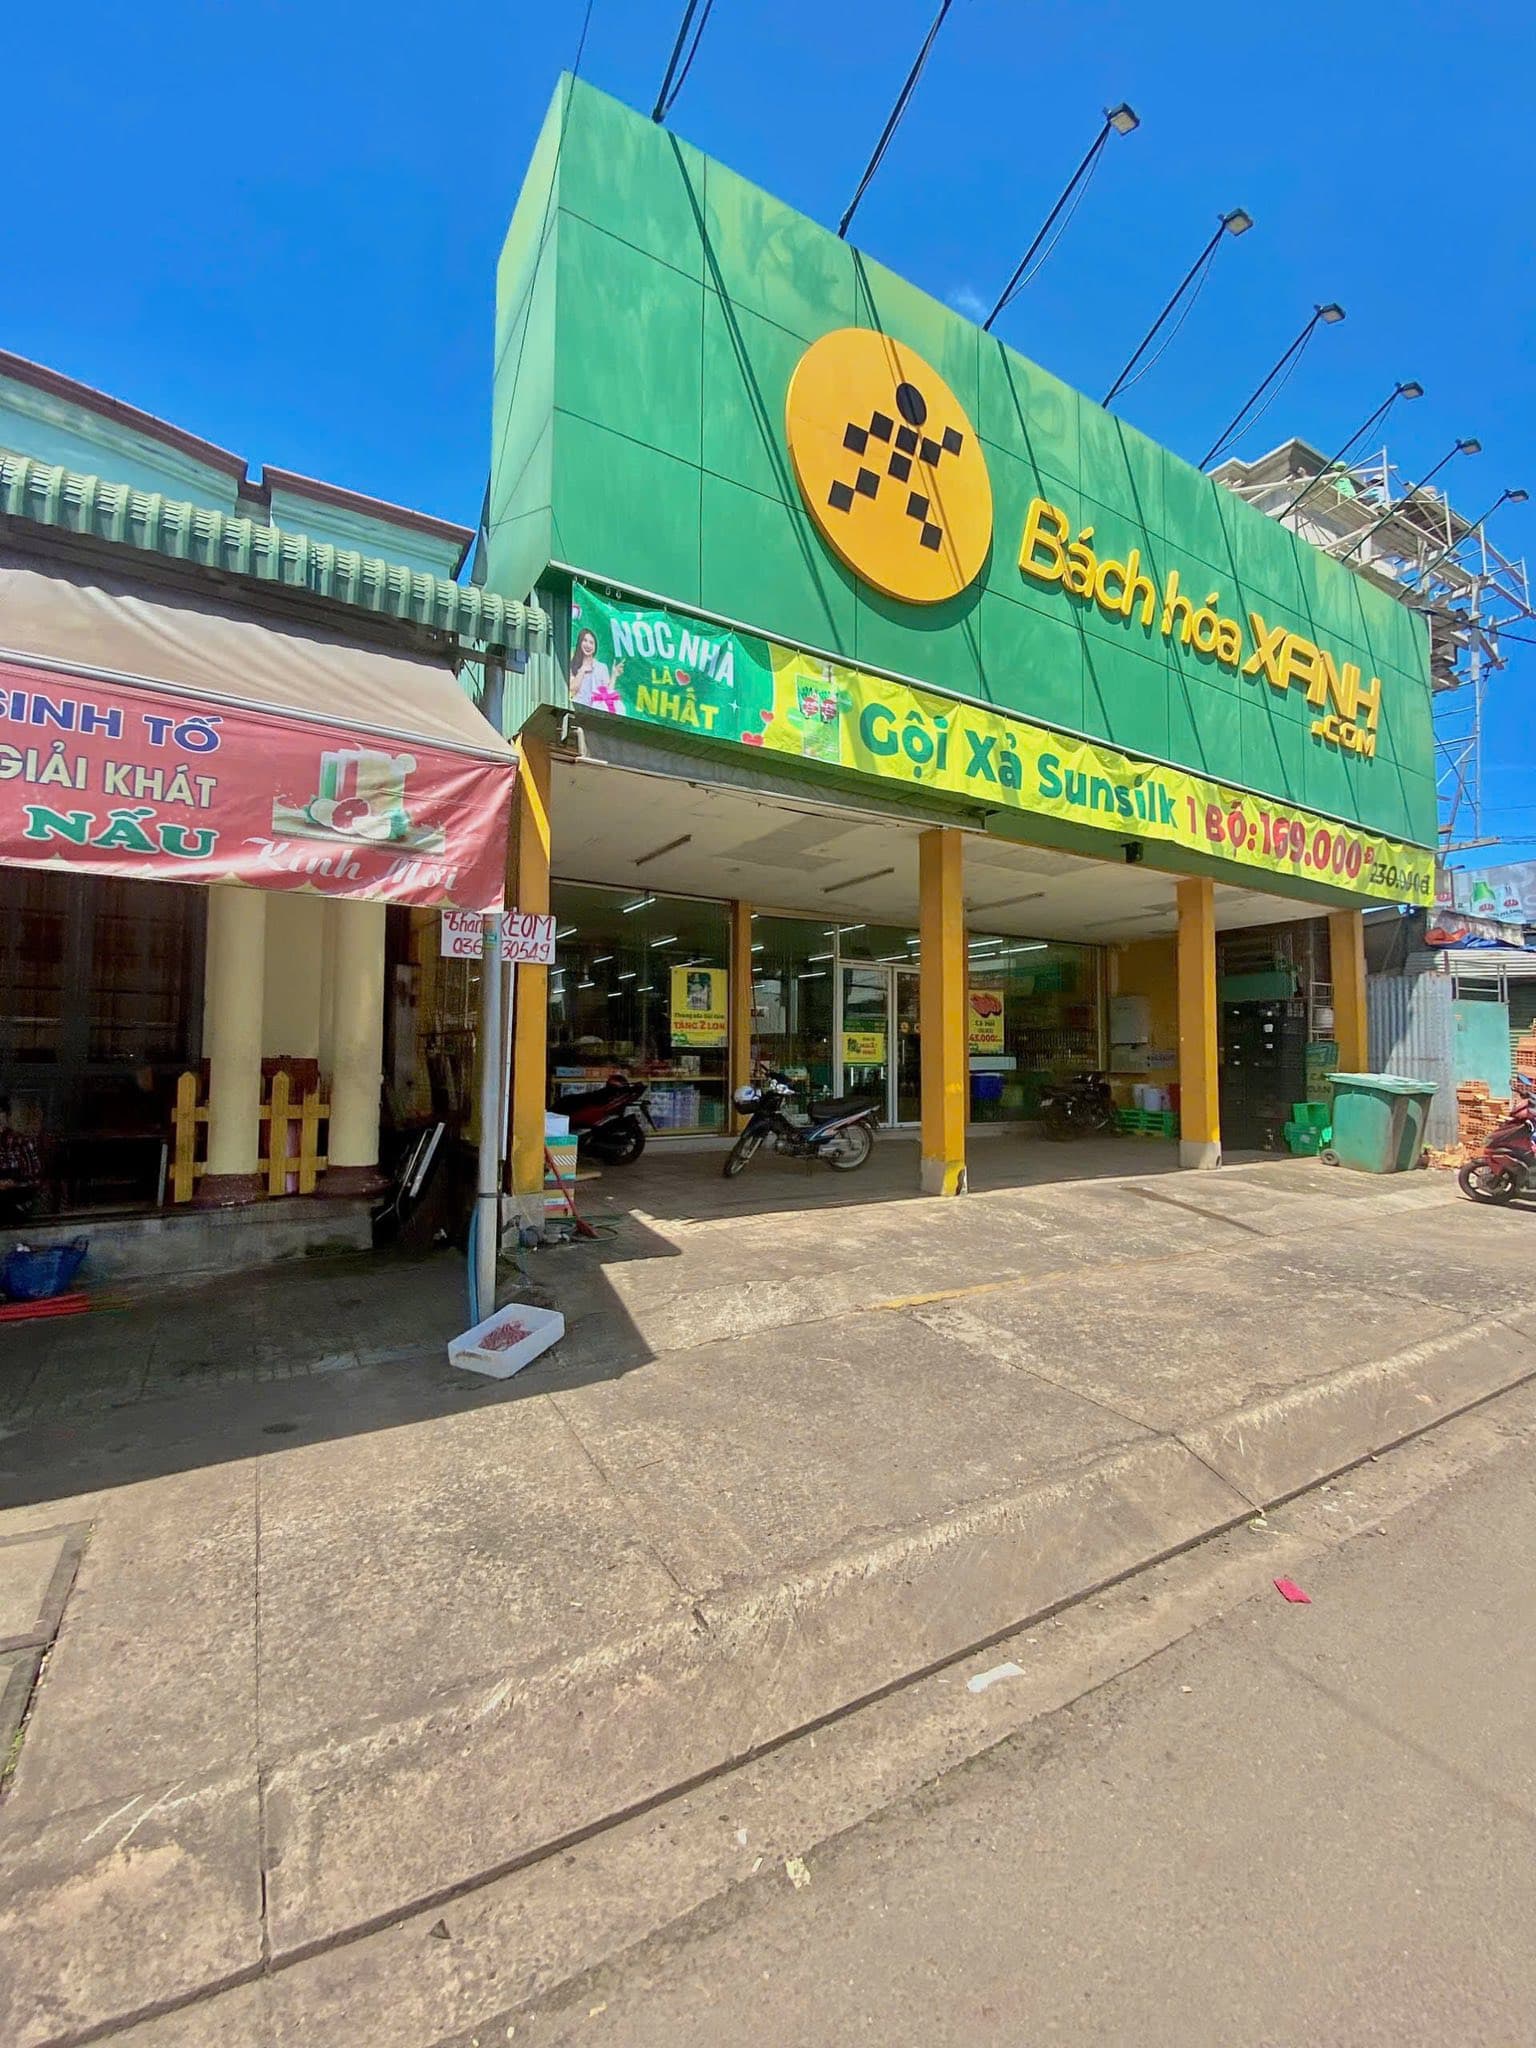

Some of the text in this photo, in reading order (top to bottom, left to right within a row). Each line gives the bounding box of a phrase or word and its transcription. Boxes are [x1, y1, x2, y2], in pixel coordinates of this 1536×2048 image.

[1018, 497, 1381, 731] Bách hóa XANH
[143, 716, 223, 753] TỐ
[1311, 714, 1376, 757] .COM
[0, 739, 218, 809] GIẢI KHÁT
[859, 702, 949, 779] Gội
[964, 729, 1022, 791] Xả
[1037, 752, 1178, 830] Sunsilk
[1186, 795, 1197, 834] 1
[23, 804, 219, 858] NẤU
